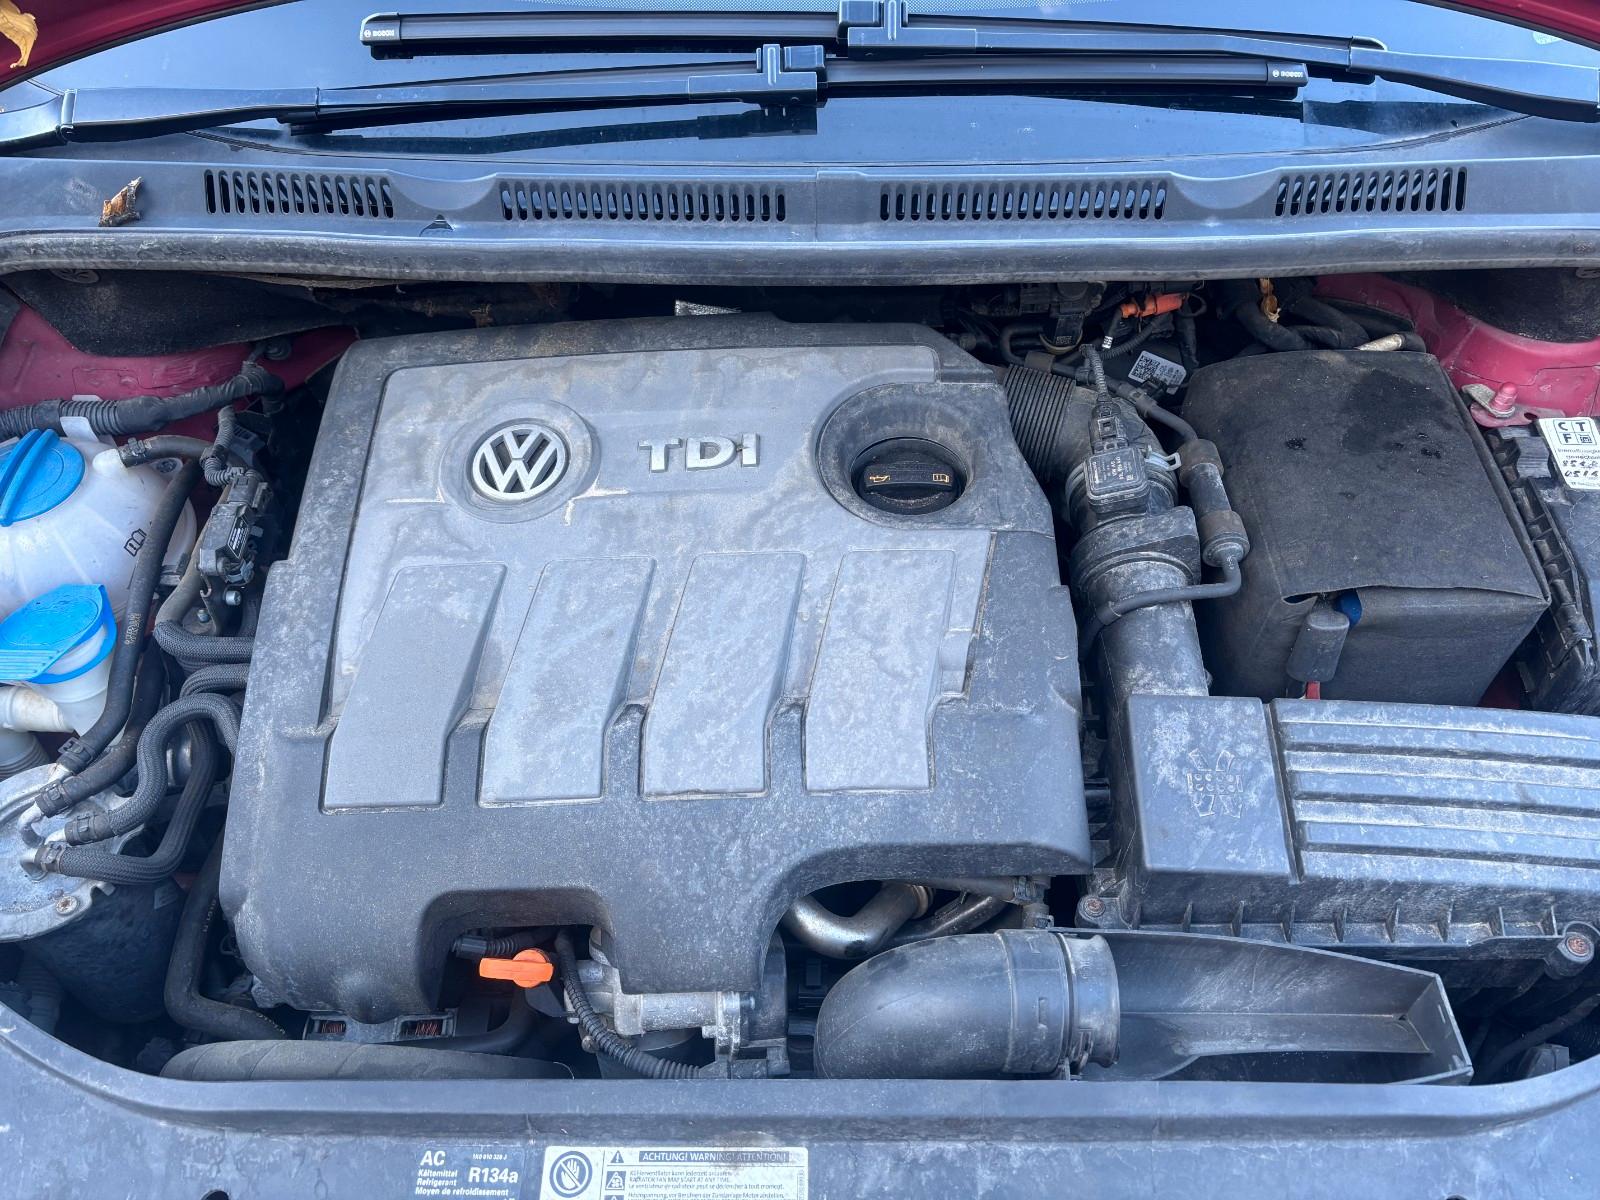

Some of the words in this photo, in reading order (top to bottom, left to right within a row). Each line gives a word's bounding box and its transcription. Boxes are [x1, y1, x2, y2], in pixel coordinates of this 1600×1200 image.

[1558, 422, 1569, 431] C
[1575, 422, 1586, 432] T
[1562, 433, 1572, 443] F
[637, 432, 761, 474] TDI
[420, 1150, 446, 1167] AC
[642, 1152, 688, 1161] ACHTUNG!
[468, 1166, 519, 1184] R134a
[416, 1177, 457, 1187] Refrigerant
[415, 1187, 440, 1196] Moyen
[441, 1187, 451, 1195] de
[452, 1187, 509, 1196] refroidissement
